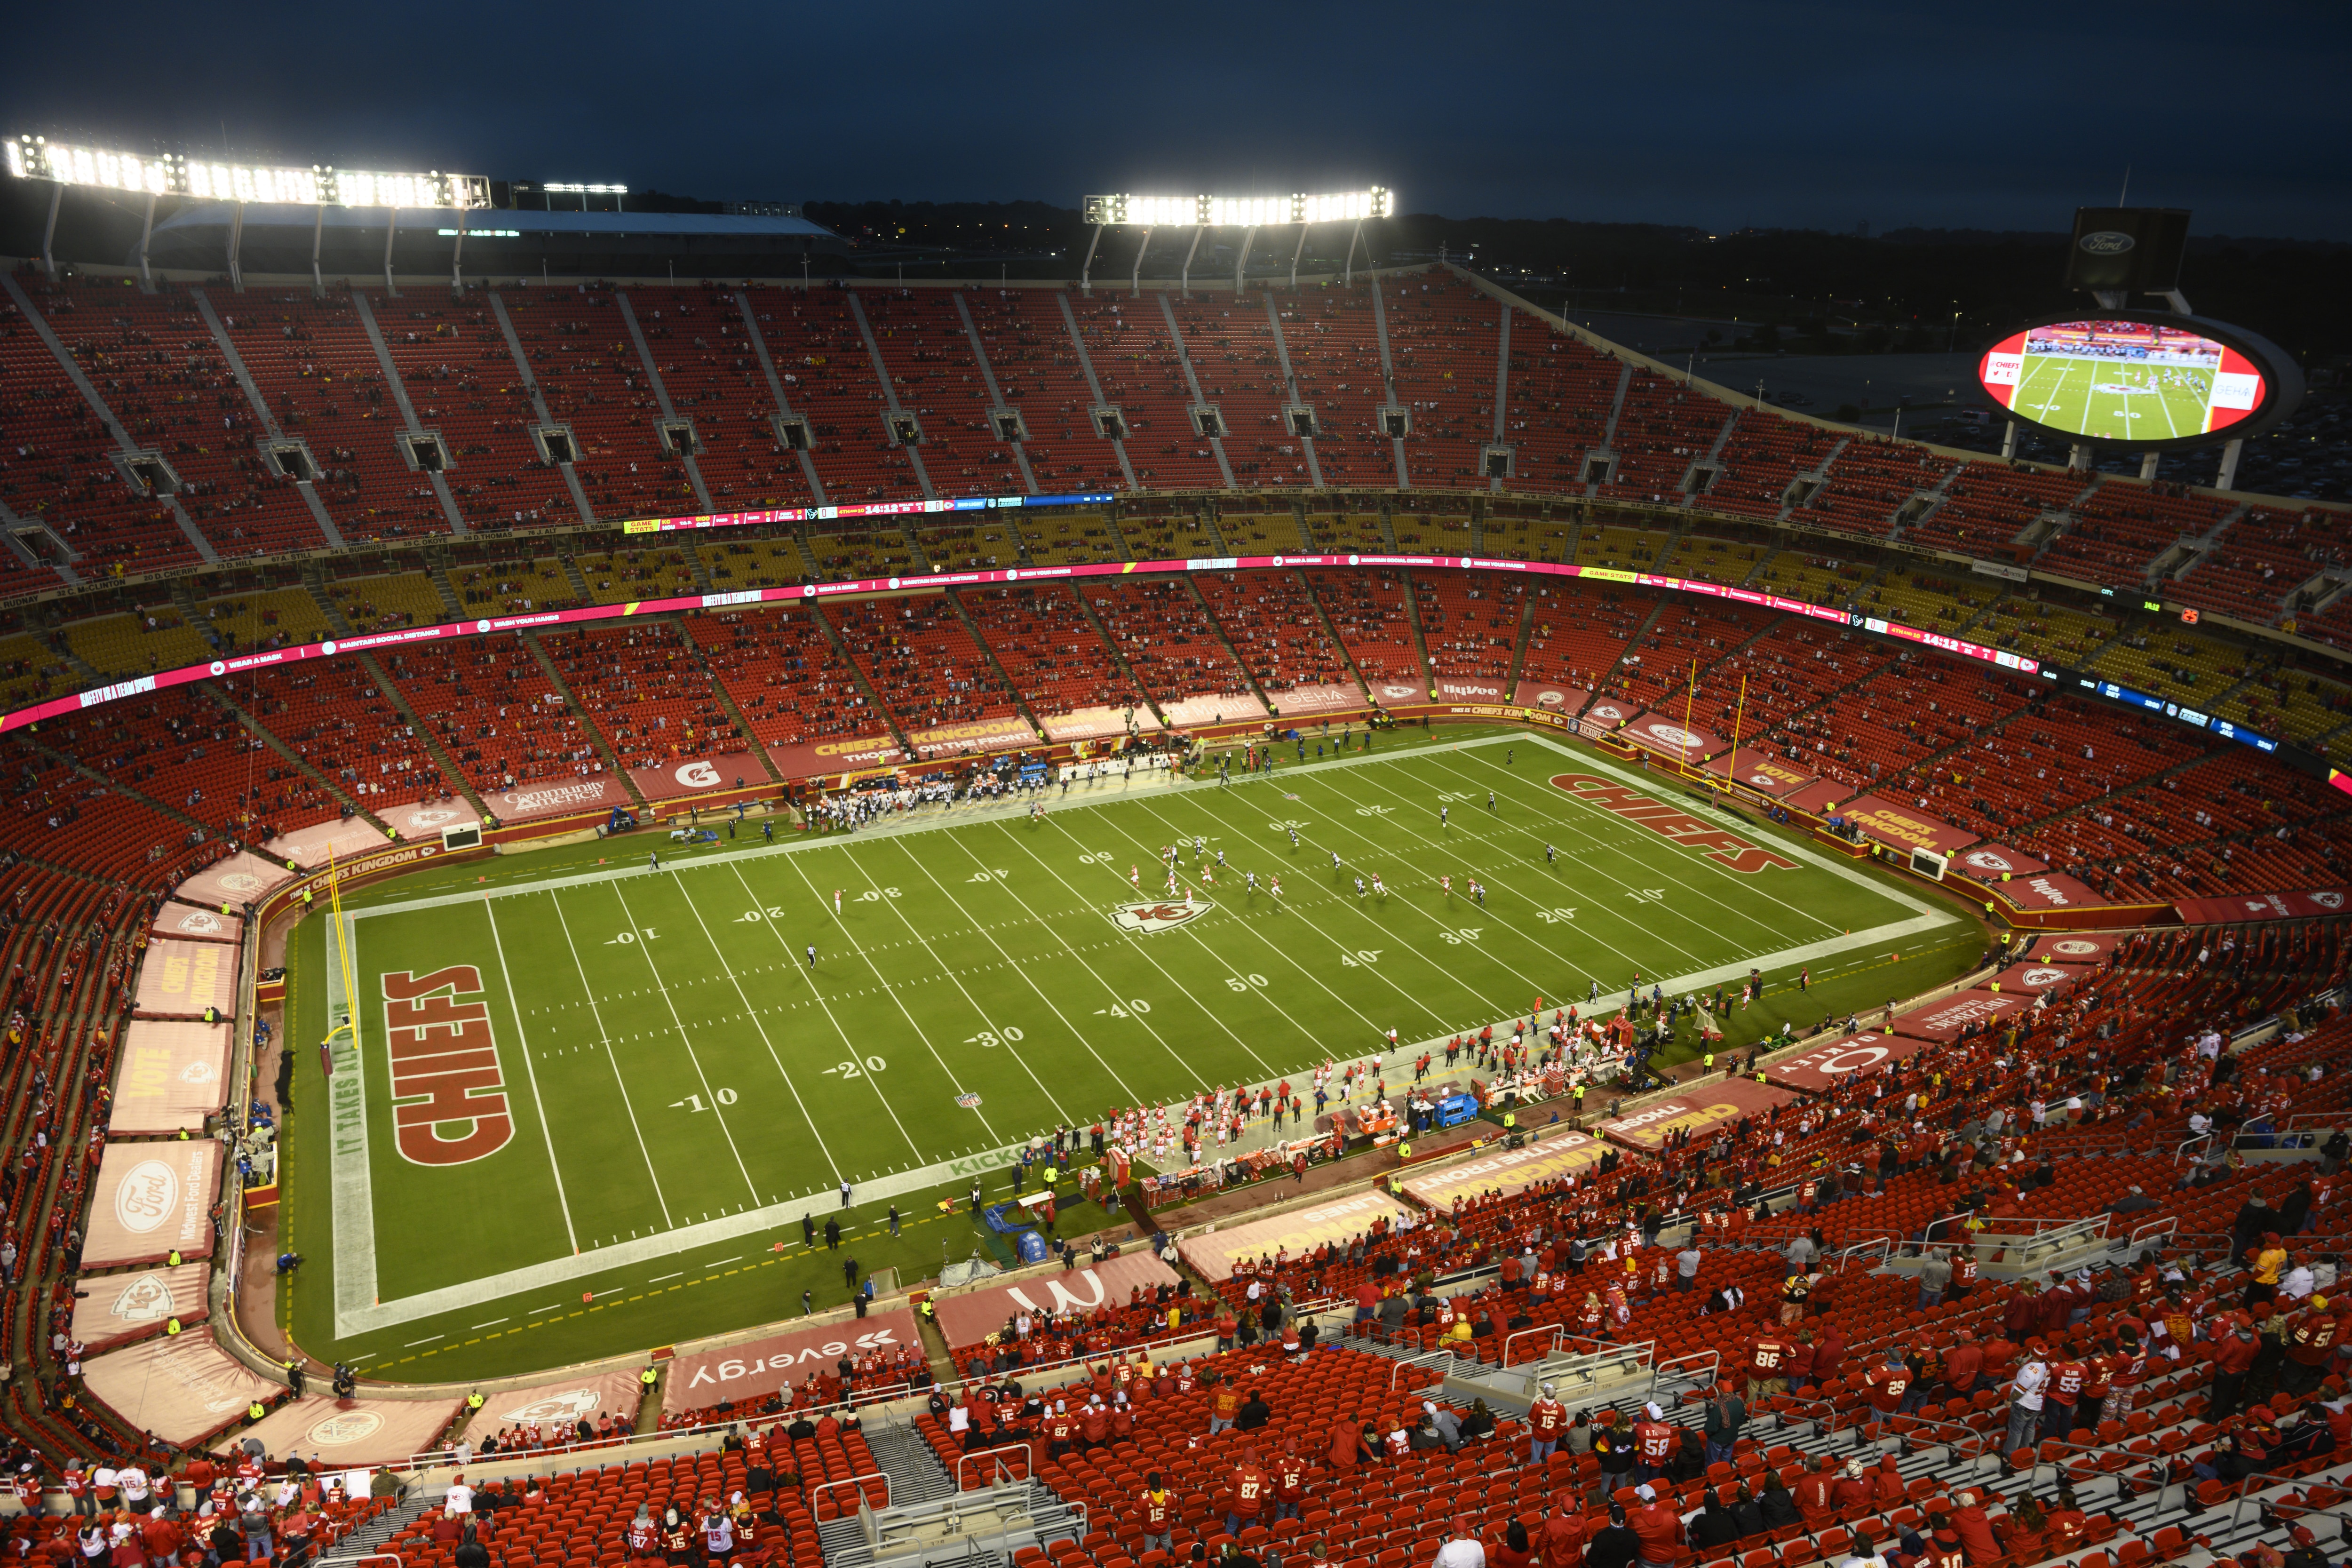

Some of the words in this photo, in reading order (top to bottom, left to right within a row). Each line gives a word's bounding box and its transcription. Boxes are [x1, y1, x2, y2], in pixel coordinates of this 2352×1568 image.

[2089, 233, 2124, 250] Ford
[1990, 361, 2020, 369] @CHIEFS
[2215, 385, 2251, 397] GEHA
[865, 504, 898, 514] 14:12
[349, 543, 387, 554] BURRUSS
[422, 537, 448, 546] OKOYE
[165, 567, 198, 579] CHERRY
[78, 579, 126, 593] McCLINTON
[4, 595, 39, 609] RUDNAY
[493, 619, 516, 628] WASH
[2183, 609, 2197, 622] 25
[340, 638, 376, 649] MAINTAIN
[376, 634, 404, 643] SOCIAL
[404, 629, 440, 639] DISTANCE
[1923, 633, 1959, 651] 14:12
[229, 657, 253, 669] WEAR
[259, 653, 283, 663] MASK
[2042, 671, 2057, 680] CAR
[79, 687, 103, 708] SAFETY
[103, 685, 112, 702] IS
[116, 680, 135, 699] TEAM
[134, 675, 156, 695] SPORT
[1285, 691, 1348, 705] GEHA
[1471, 706, 1503, 716] CHIEFS
[1504, 708, 1551, 723] KINDOM
[911, 720, 1026, 745] KINGDOM
[1051, 724, 1095, 735] LINES
[1657, 726, 1695, 746] Ford
[815, 736, 893, 756] CHIEFS
[918, 742, 940, 753] ON
[942, 738, 977, 750] THE
[977, 732, 1030, 746] FRONT
[1629, 728, 1656, 742] Midwest
[1654, 738, 1669, 749] Ford
[1668, 743, 1692, 756] Dealers
[843, 748, 900, 763] THOSE
[1754, 763, 1805, 784] VOTE
[504, 781, 606, 805] Community
[515, 790, 605, 811] America
[1736, 789, 1752, 799] TOUCHDOWN
[1657, 789, 1691, 805] END
[1693, 803, 1759, 834] RACISM
[1549, 773, 1804, 874] CHIEFS
[1843, 809, 1939, 849] KINGDOM
[1873, 810, 1938, 836] CHIEFS
[351, 849, 417, 876] KINGDOM
[161, 955, 190, 993] CHIEFS
[190, 948, 220, 1005] KINGDOM
[1225, 973, 1269, 993] 50
[1923, 999, 1983, 1022] DIAMONDS
[1925, 998, 2014, 1031] HELZBERG
[334, 1045, 358, 1074] ALL
[1779, 1035, 1878, 1075] OAKLEY
[128, 1047, 171, 1098] VOTE
[381, 964, 516, 1167] CHIEFS
[334, 1078, 361, 1132] TAKES
[1608, 1105, 1687, 1131] THOSE
[1642, 1104, 1740, 1144] CHIEFS
[337, 1138, 363, 1156] IT
[1552, 1135, 1587, 1151] ON
[1501, 1147, 1553, 1165] THE
[186, 1151, 203, 1181] Dealers
[1428, 1143, 1613, 1204] KINGDOM
[1417, 1162, 1500, 1191] FRONT
[125, 1175, 167, 1218] Ford
[185, 1182, 200, 1202] Ford
[1303, 1195, 1385, 1222] LINES
[180, 1202, 199, 1240] Midwest
[1963, 1266, 1977, 1278] 15
[688, 1341, 848, 1389] evergy
[1756, 1351, 1780, 1368] 86
[1921, 1363, 1938, 1379] 55
[1887, 1380, 1906, 1395] 29
[2059, 1376, 2082, 1393] 55
[1541, 1415, 1556, 1429] 15
[1055, 1426, 1069, 1437] 87
[1645, 1438, 1669, 1456] 58
[125, 1480, 136, 1488] 15
[1284, 1473, 1299, 1488] 15
[1241, 1483, 1259, 1499] 87
[1150, 1508, 1165, 1523] 15
[633, 1535, 648, 1548] 87
[670, 1537, 686, 1549] 15
[709, 1530, 722, 1542] 15
[740, 1528, 754, 1540] 15
